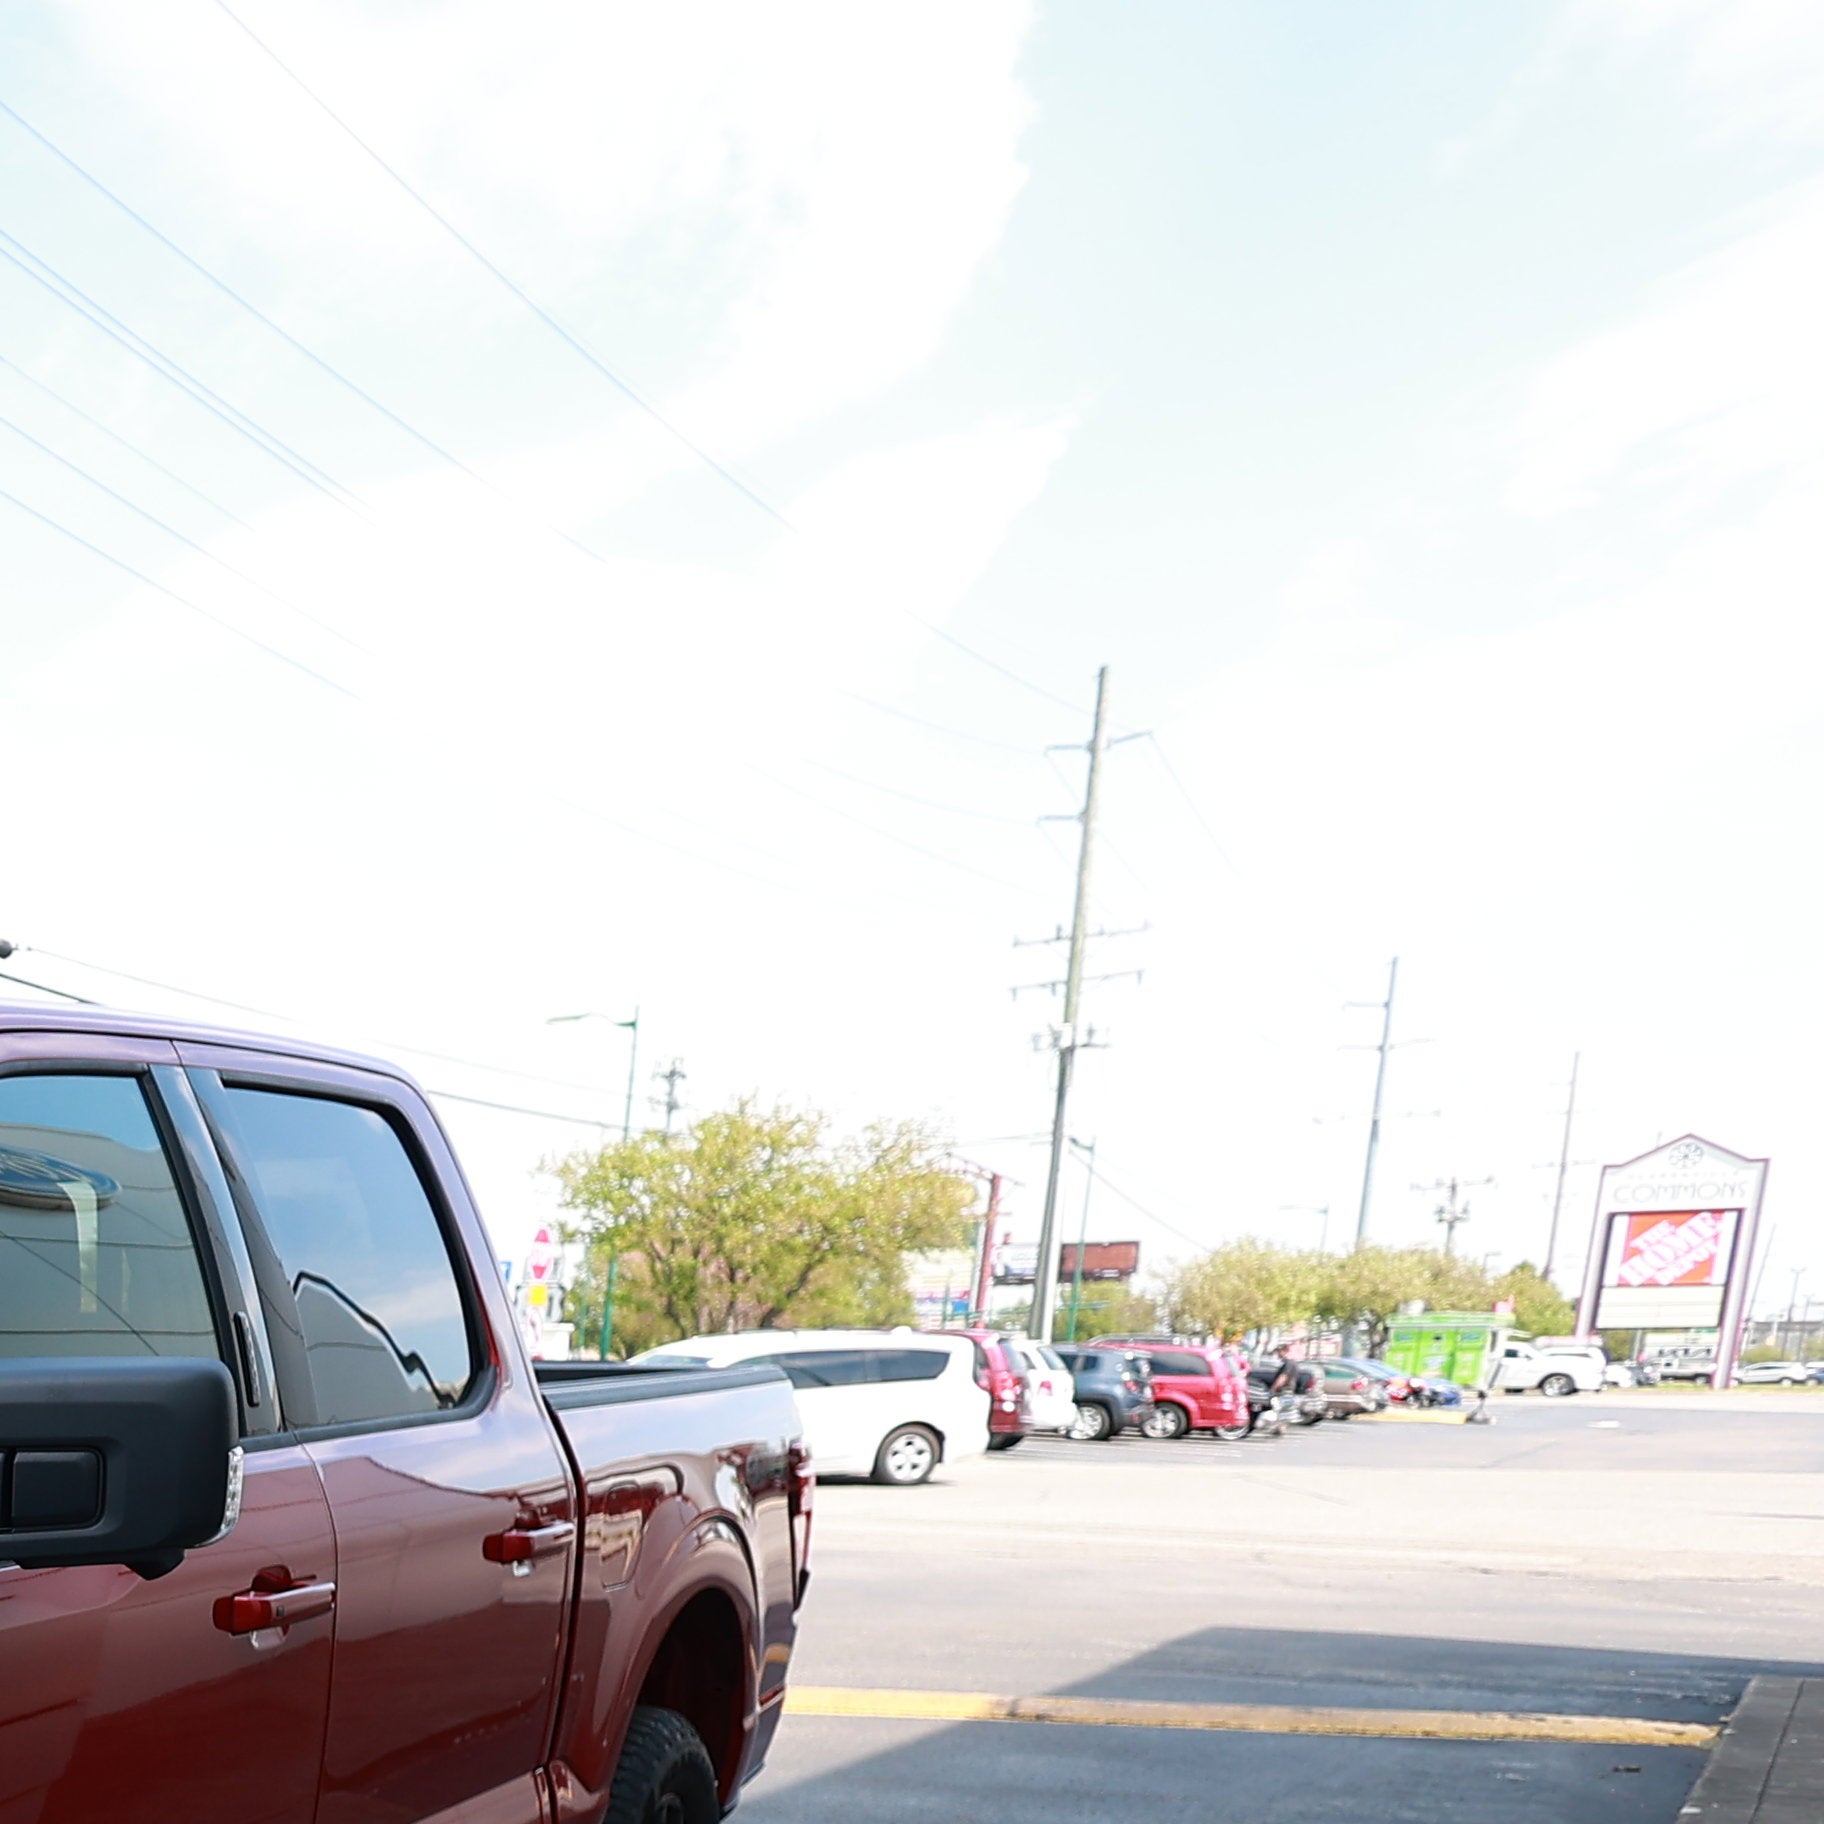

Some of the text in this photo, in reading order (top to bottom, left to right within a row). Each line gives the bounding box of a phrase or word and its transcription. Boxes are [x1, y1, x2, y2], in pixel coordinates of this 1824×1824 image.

[1613, 1180, 1748, 1204] COMMONS
[1619, 1211, 1722, 1287] HOME
[1629, 1219, 1677, 1248] THE
[1653, 1238, 1717, 1286] DEPOT
